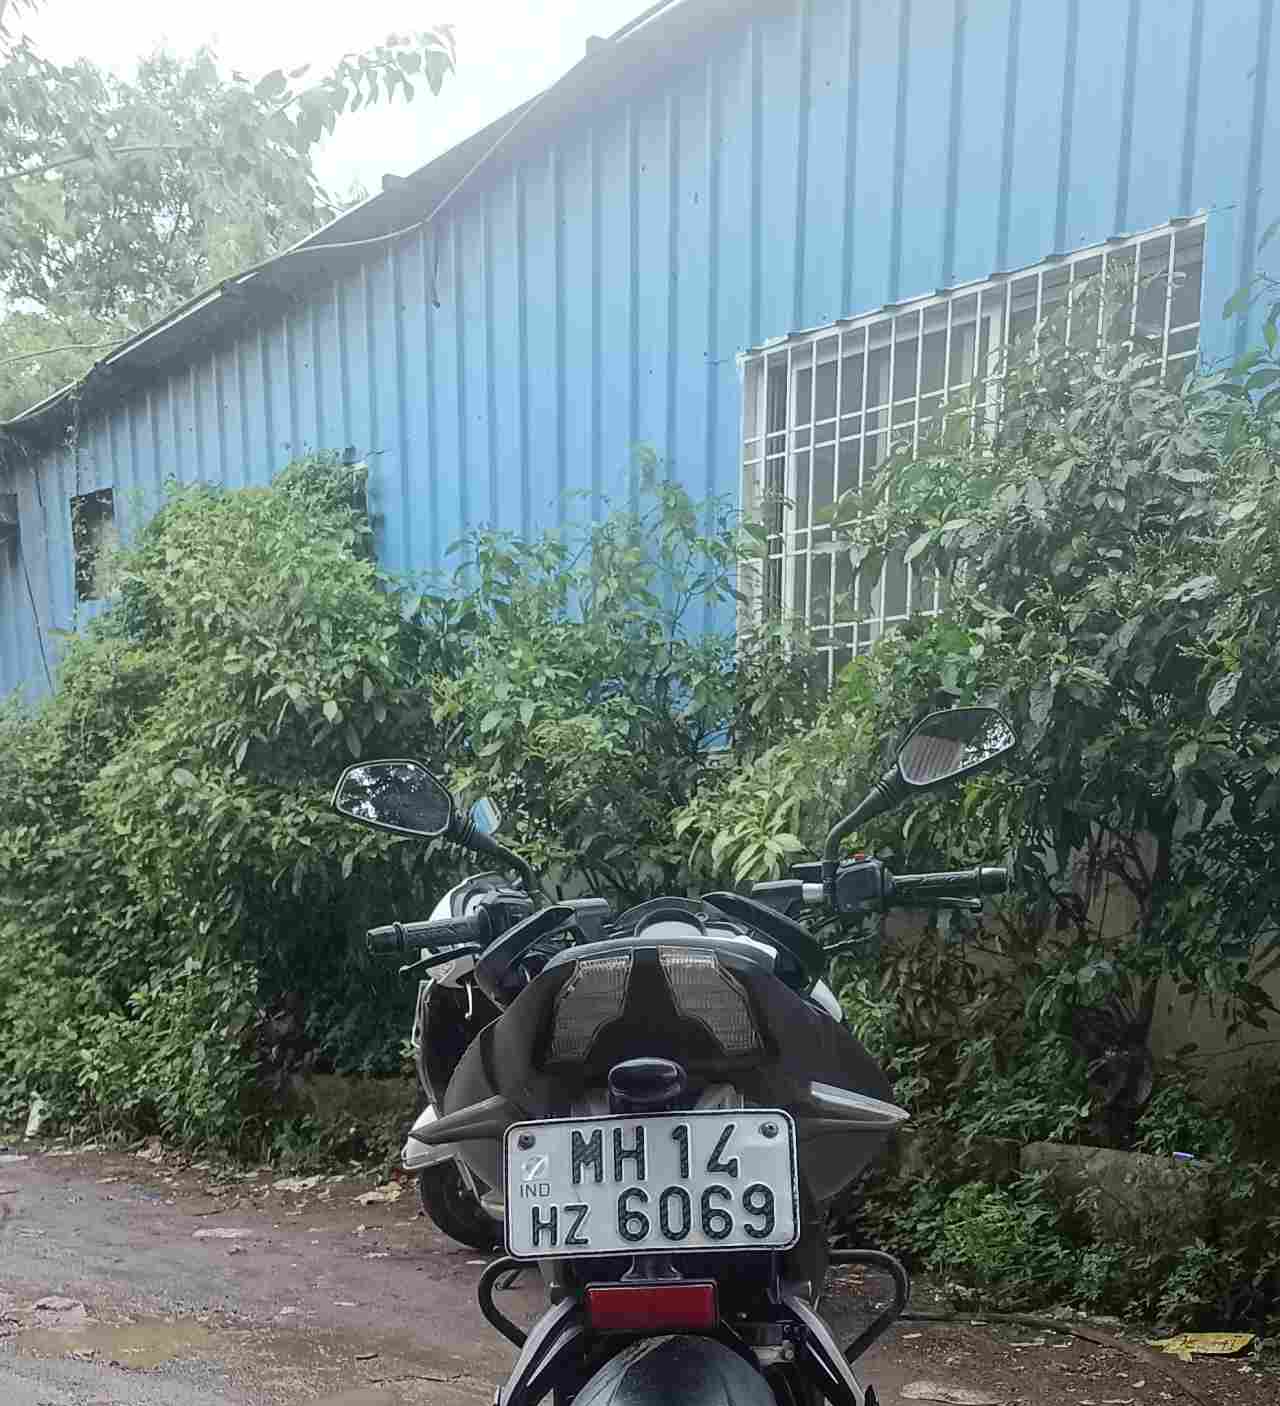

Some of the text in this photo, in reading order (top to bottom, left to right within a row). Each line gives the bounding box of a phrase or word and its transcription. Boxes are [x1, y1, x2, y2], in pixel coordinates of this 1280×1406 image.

[570, 1123, 739, 1184] MH 14
[519, 1183, 551, 1199] IND
[531, 1183, 776, 1247] HZ 6069
